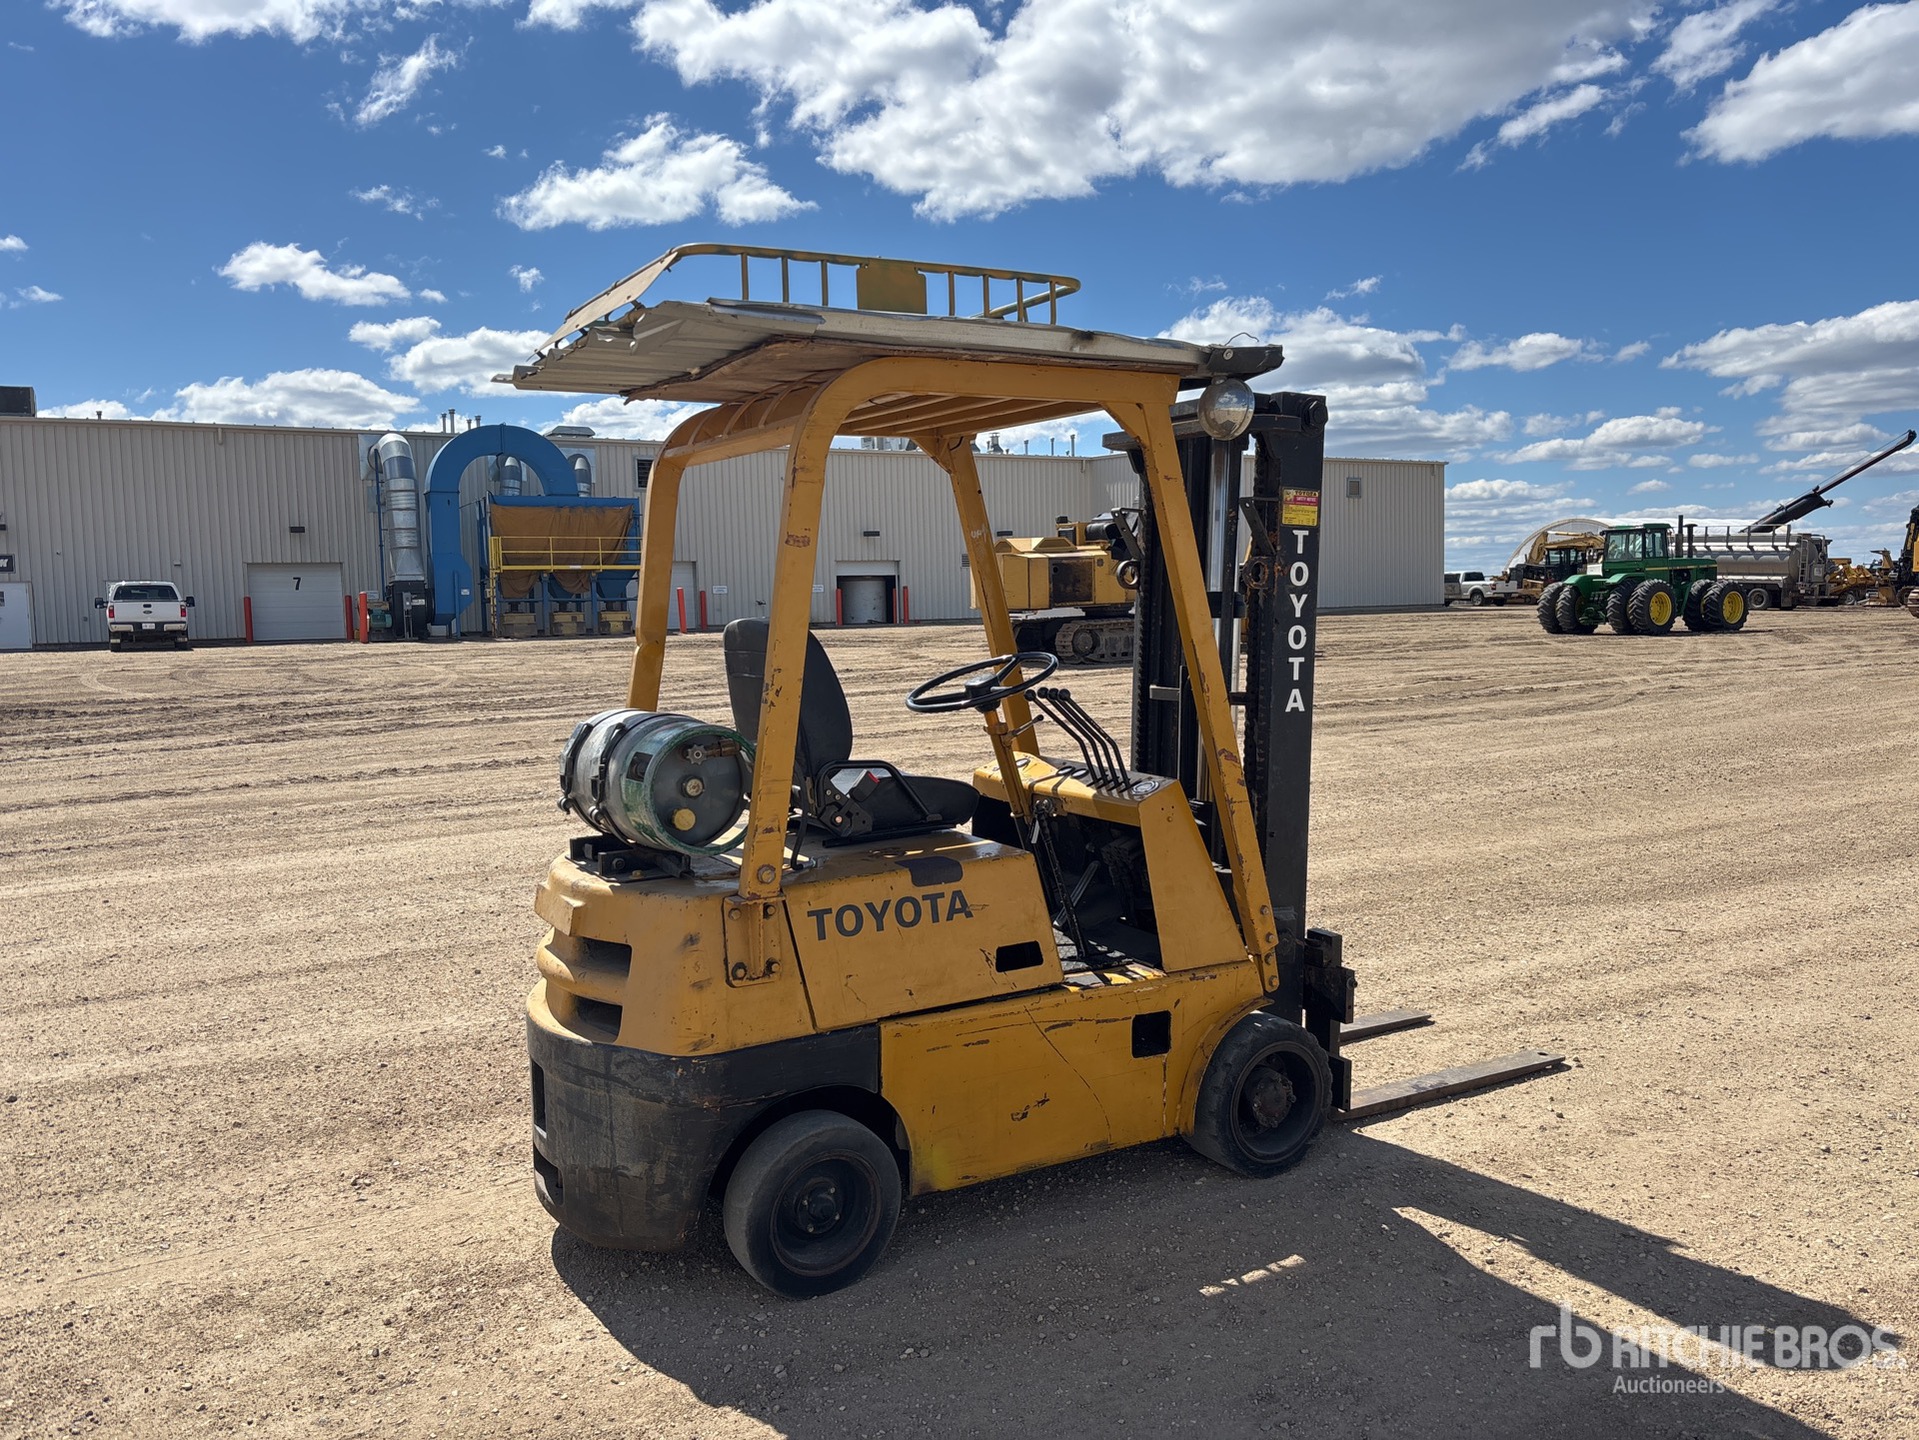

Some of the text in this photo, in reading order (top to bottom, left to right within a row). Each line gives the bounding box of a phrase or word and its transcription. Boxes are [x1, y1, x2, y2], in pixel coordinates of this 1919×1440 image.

[292, 576, 302, 591] 7
[1285, 529, 1309, 713] TOYOTA
[806, 889, 974, 942] TOYOTA
